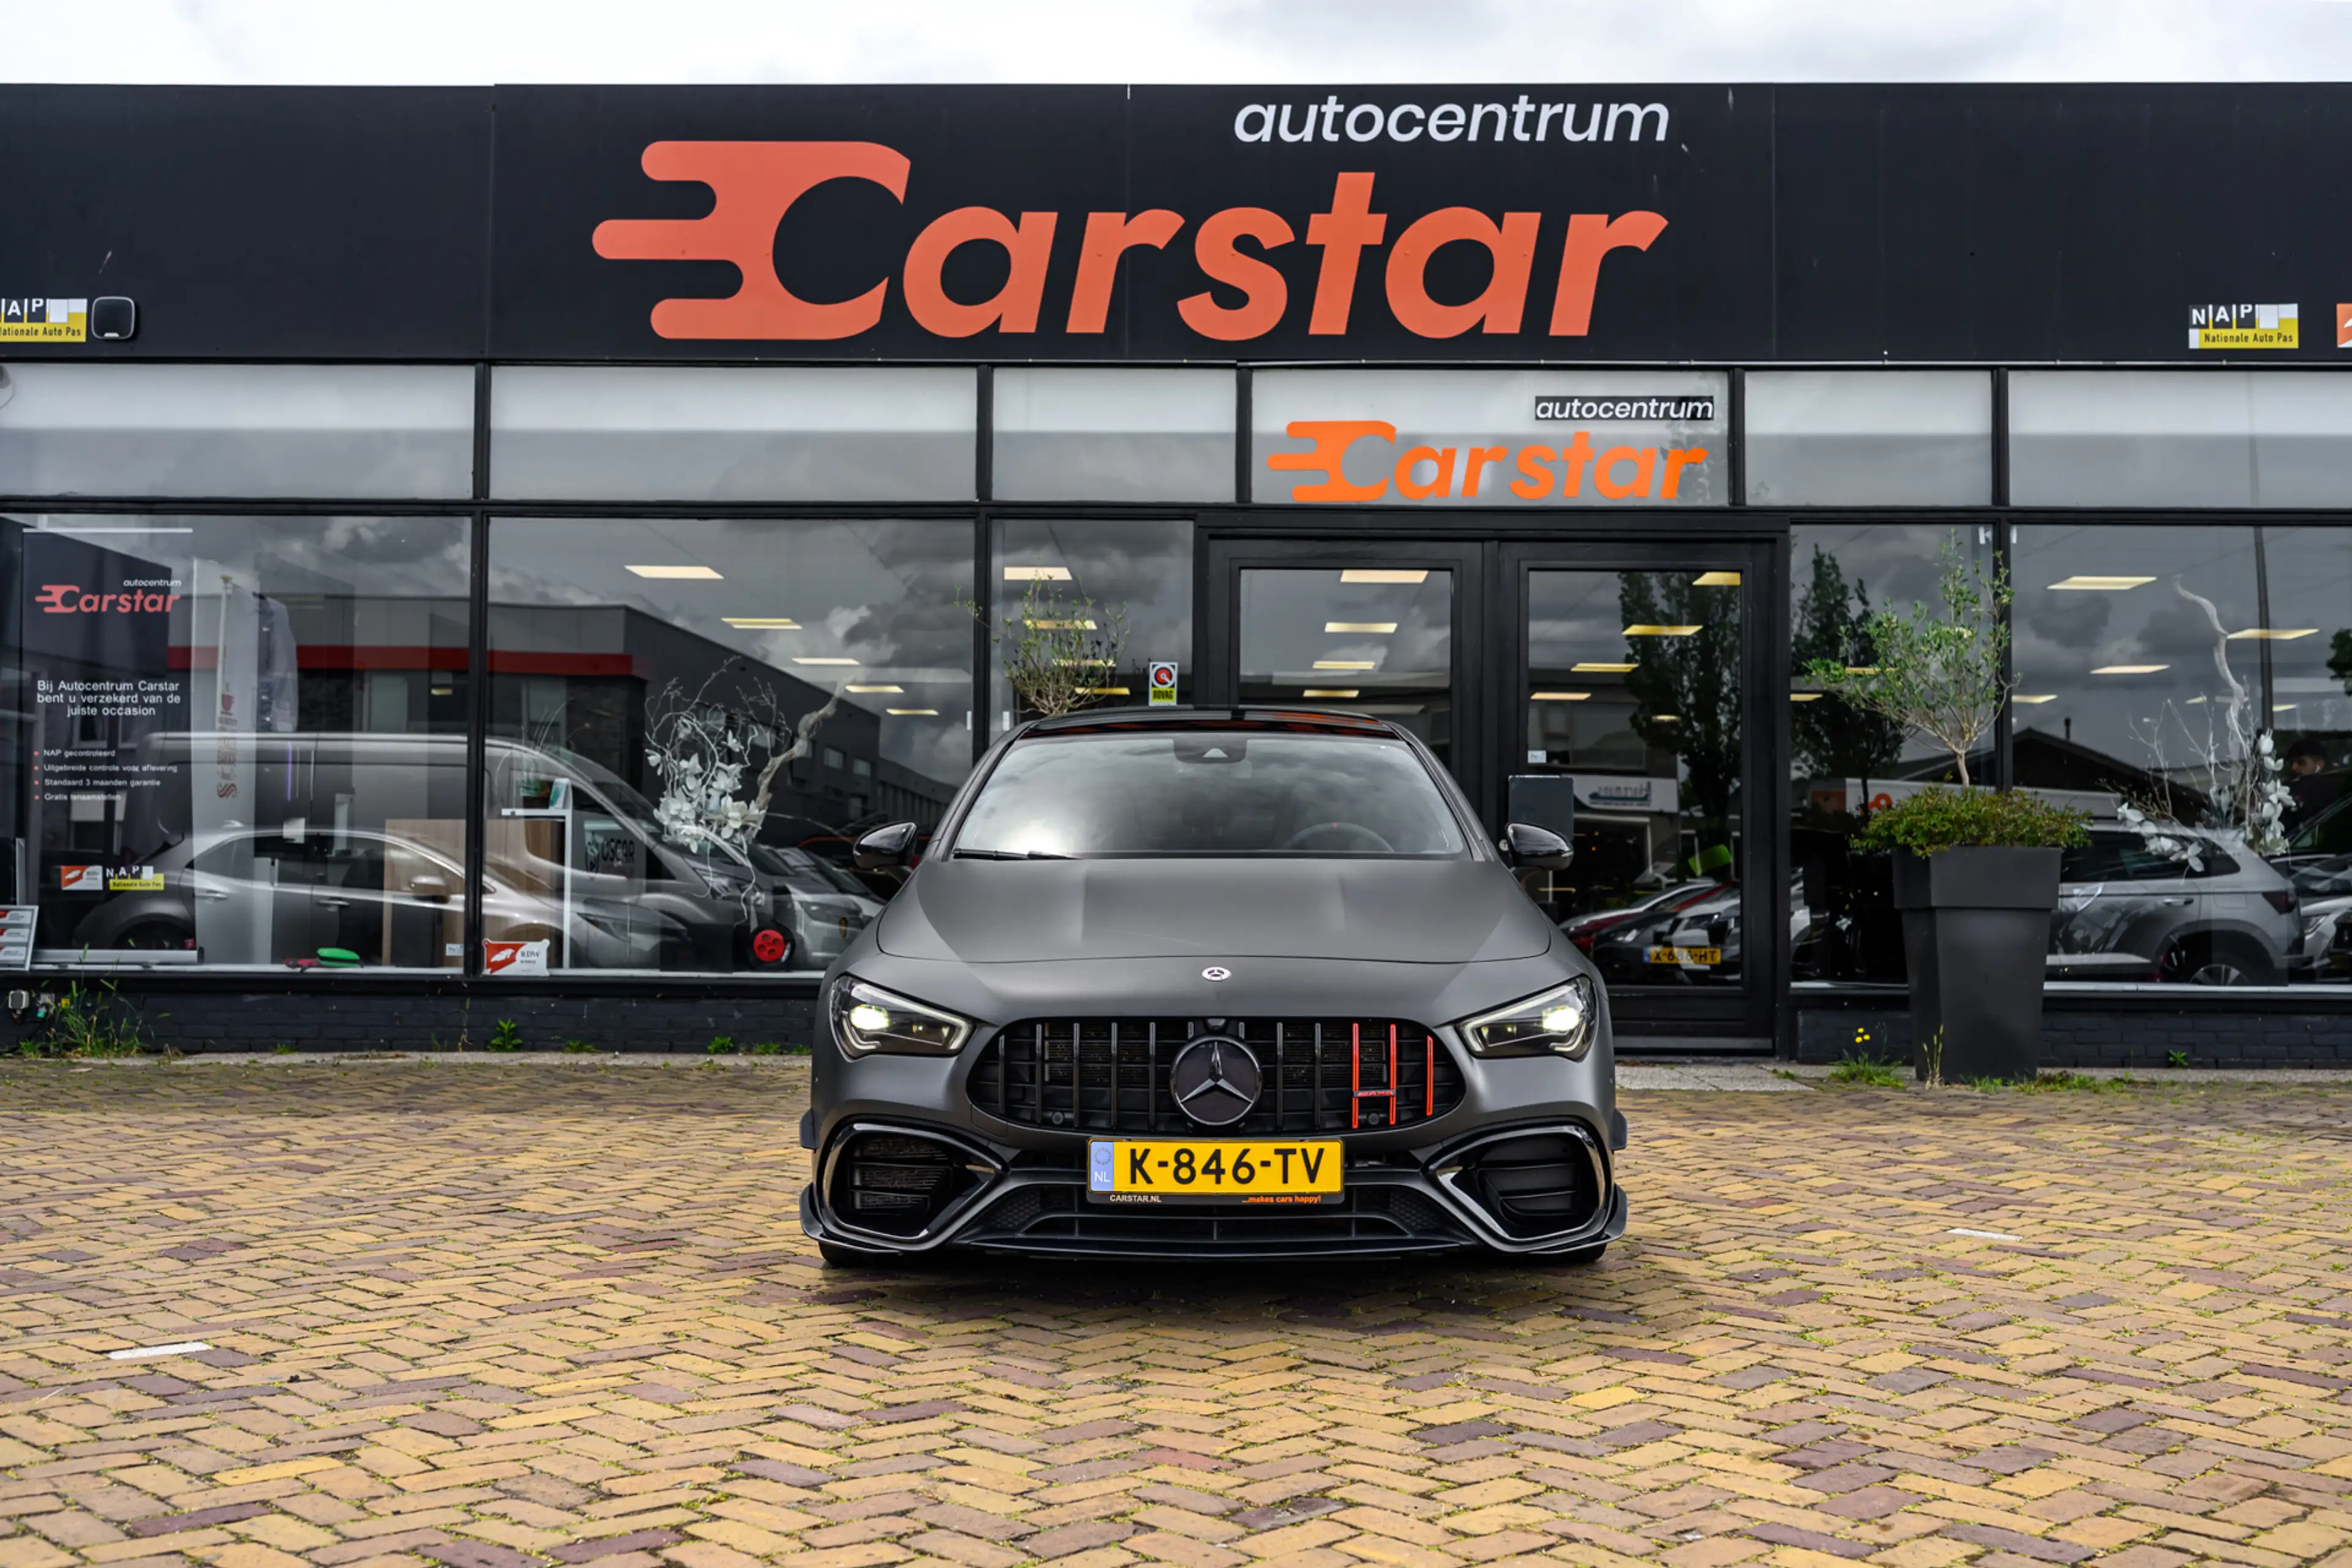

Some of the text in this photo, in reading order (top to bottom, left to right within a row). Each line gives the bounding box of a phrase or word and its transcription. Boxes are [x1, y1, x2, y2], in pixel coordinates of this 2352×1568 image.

[1234, 95, 1669, 142] autocentrum
[592, 140, 1668, 341] Carstar
[2192, 304, 2253, 325] NAP
[42, 326, 63, 336] Auto
[66, 326, 81, 336] Pas
[2204, 333, 2293, 343] Nationale Auto Pas
[1536, 397, 1713, 420] autocentrum
[1267, 420, 1709, 502] Carstar
[35, 584, 181, 613] Carstar
[37, 680, 180, 693] Bij Autocentrum Carstar
[37, 693, 64, 703] bent
[80, 693, 138, 704] verzekerd
[143, 695, 163, 704] van
[167, 693, 181, 704] de
[67, 705, 156, 718] juiste occasion
[64, 750, 115, 758] gecontroleerd
[43, 764, 87, 773] Uitgebreide
[130, 779, 161, 788] garantie
[105, 865, 140, 878] NAP
[1129, 1148, 1325, 1185] K-846-TV
[1095, 1171, 1111, 1183] NL
[1109, 1194, 1162, 1203] CARSTAR.NL
[1294, 1195, 1322, 1204] happy!
